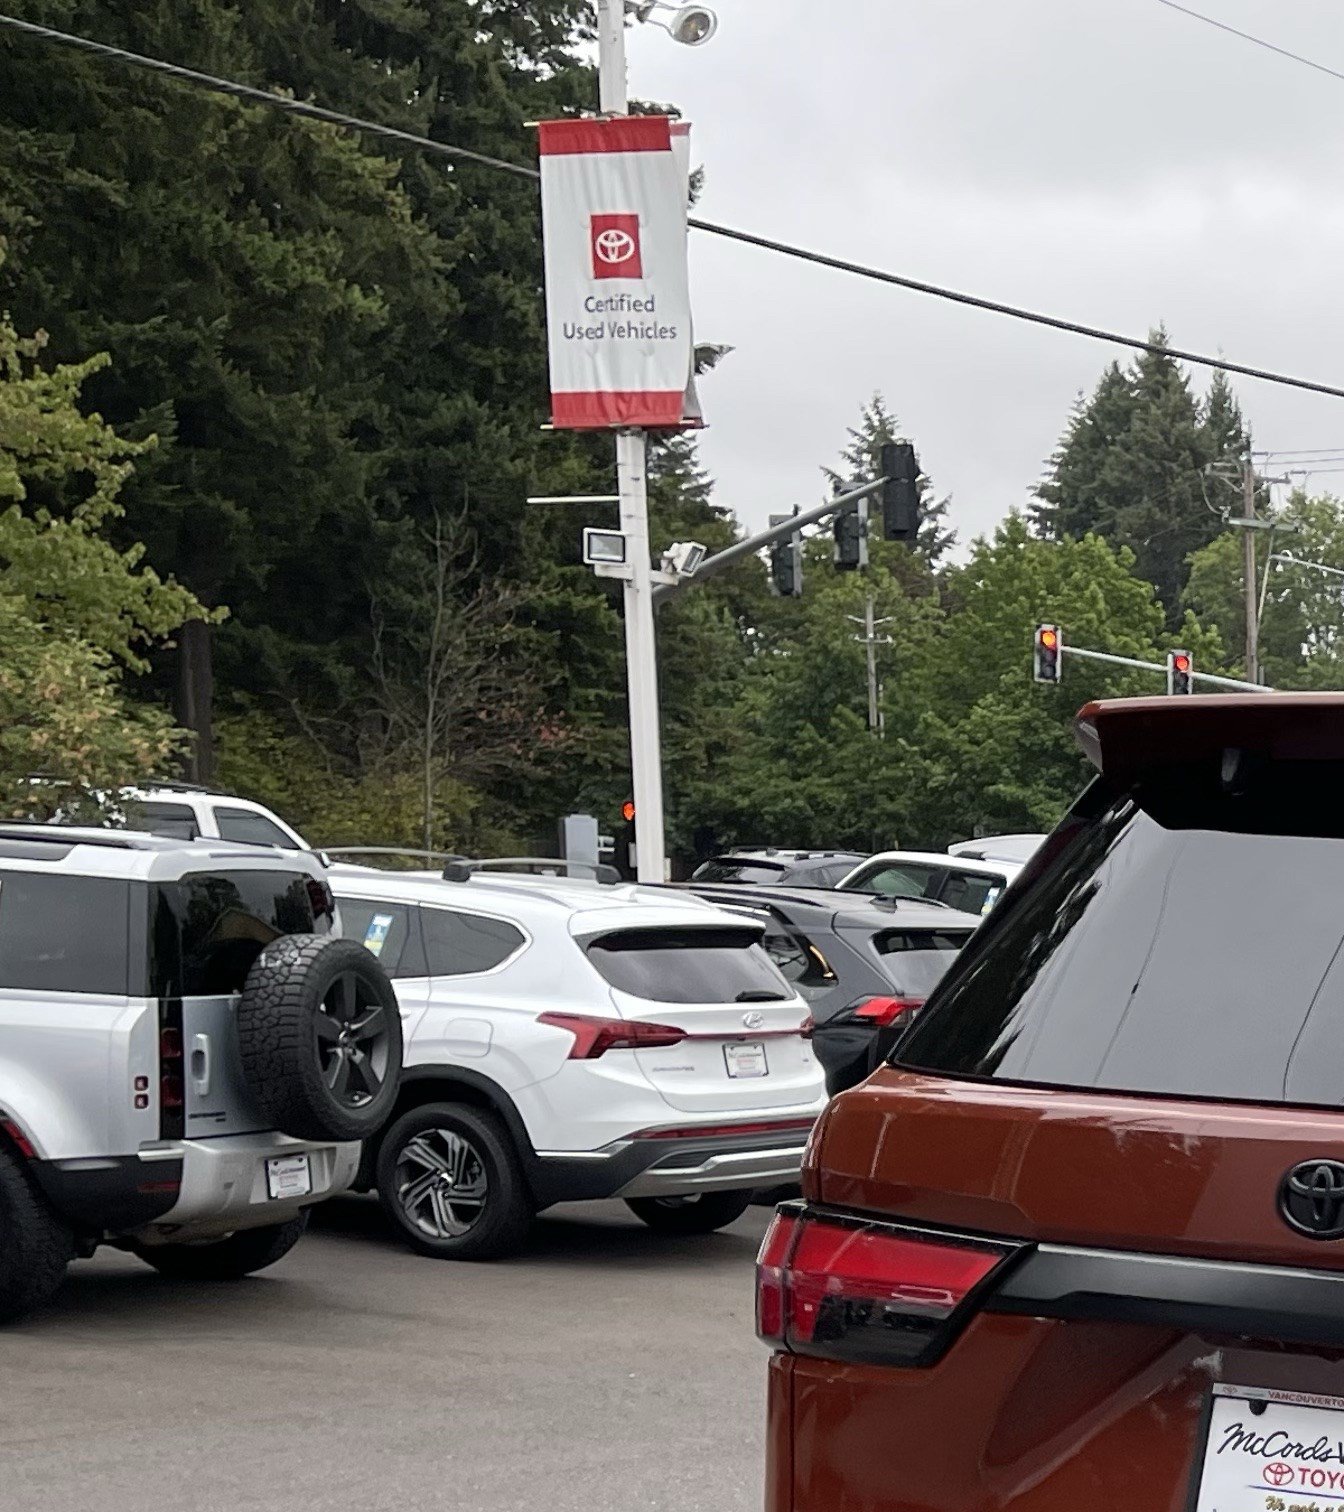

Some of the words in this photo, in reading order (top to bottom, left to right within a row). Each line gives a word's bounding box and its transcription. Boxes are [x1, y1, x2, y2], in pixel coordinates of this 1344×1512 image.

[584, 293, 655, 313] Certified
[563, 321, 604, 339] Used
[607, 320, 677, 339] Vehicles
